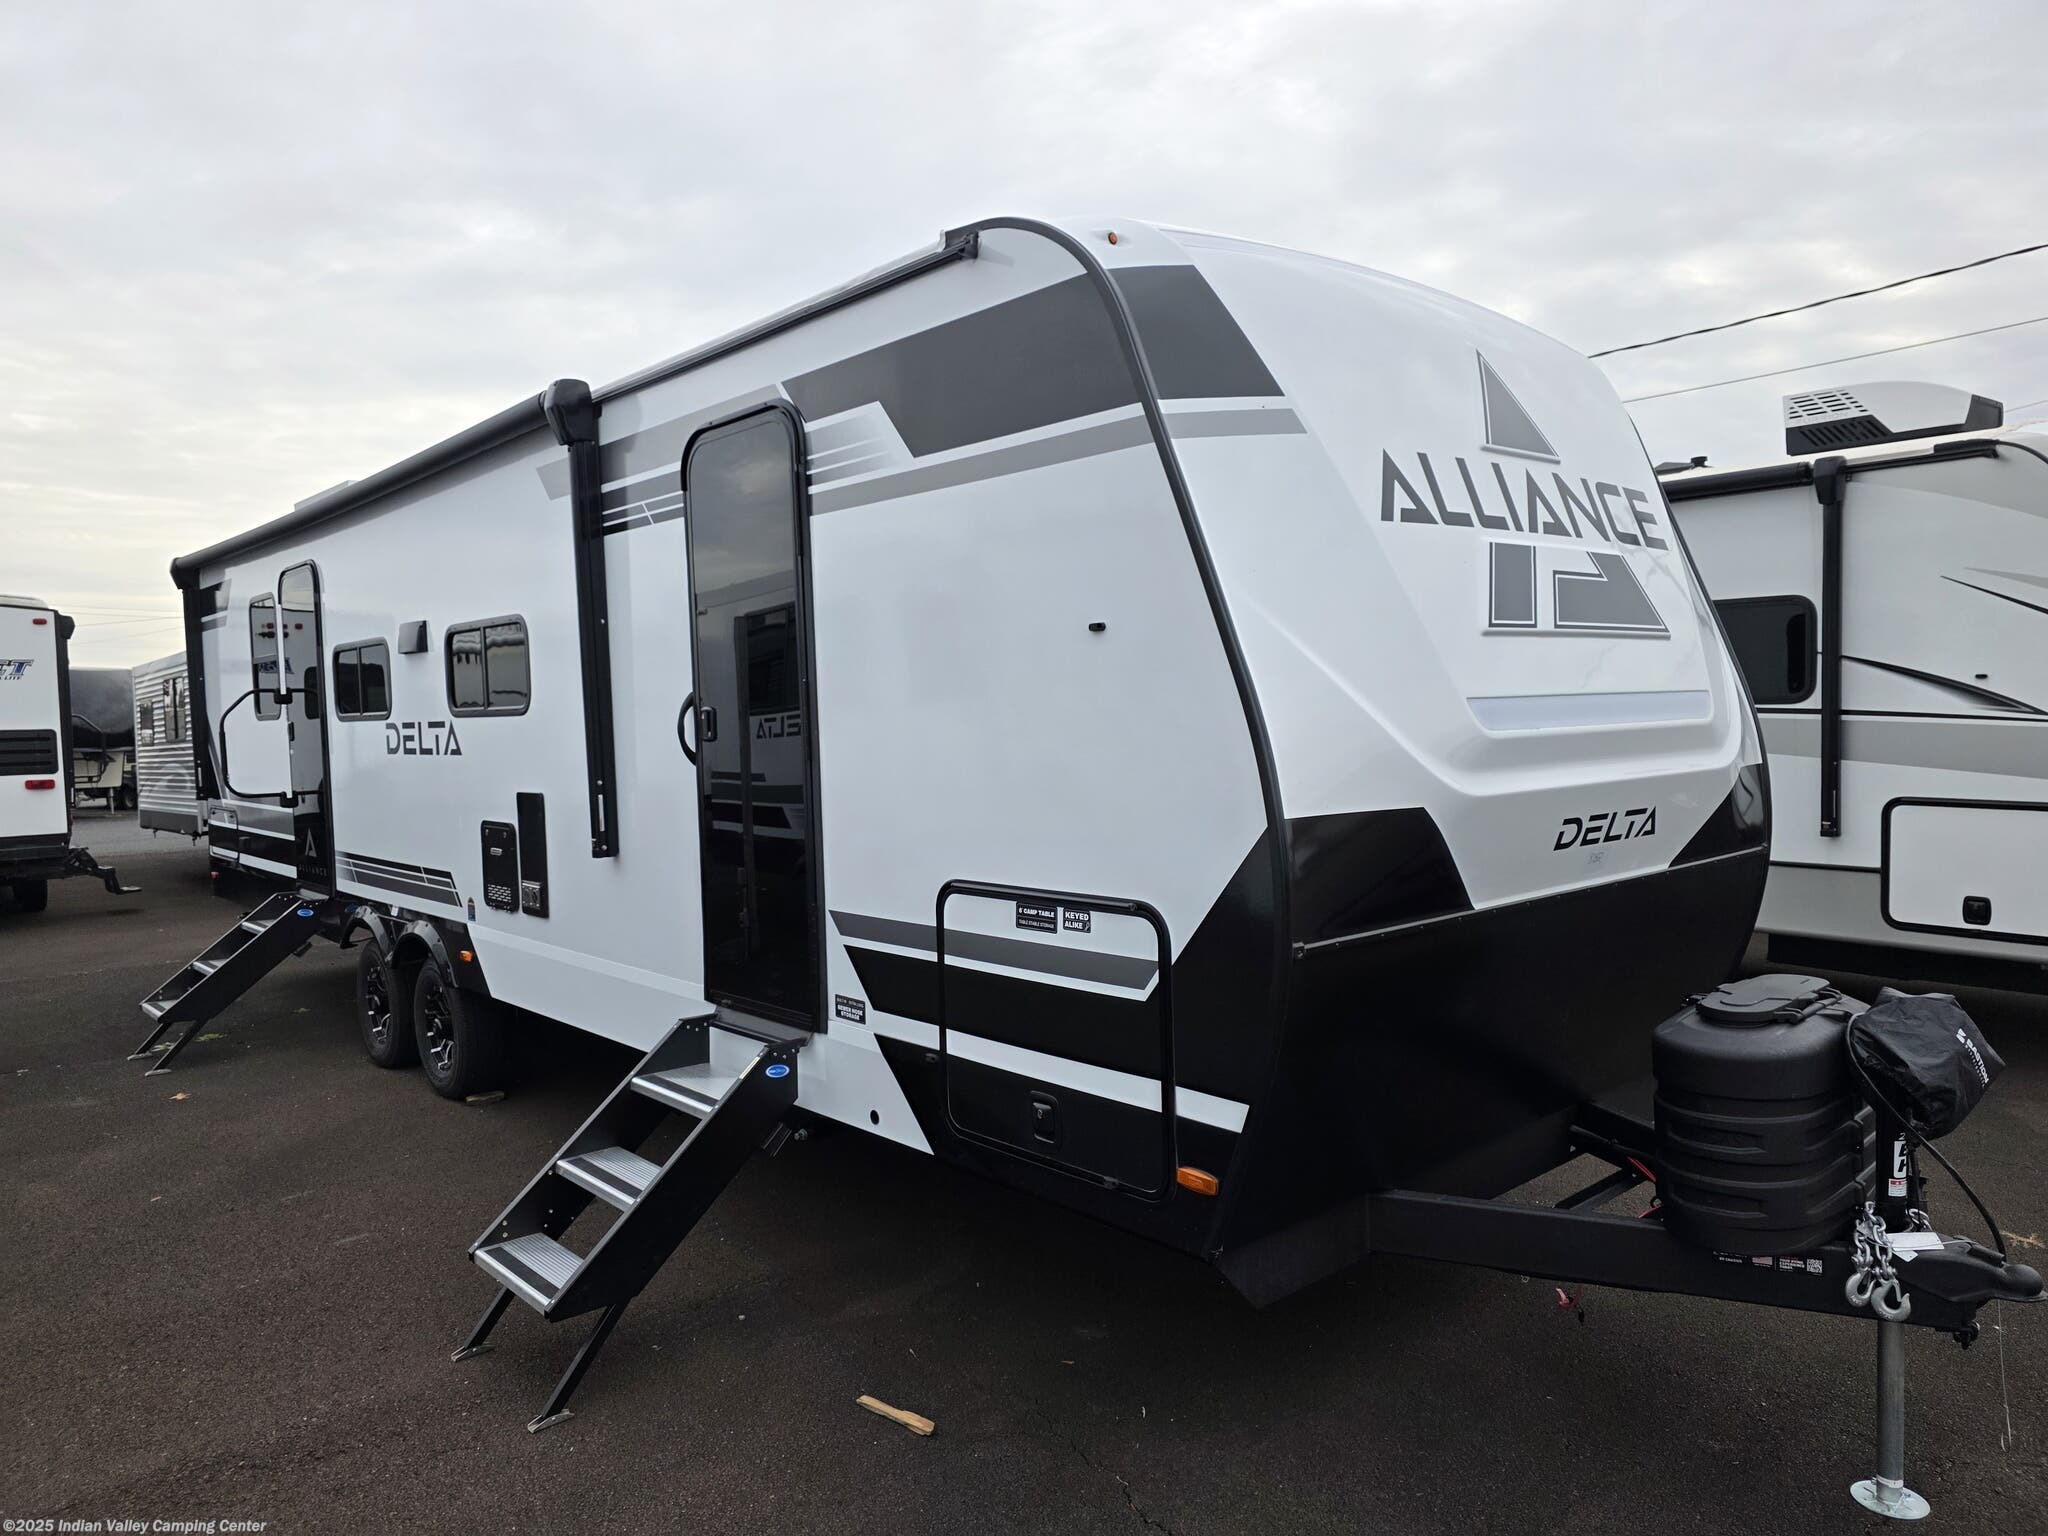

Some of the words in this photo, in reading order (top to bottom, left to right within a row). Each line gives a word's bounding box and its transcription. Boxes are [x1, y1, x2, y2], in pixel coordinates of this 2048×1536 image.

[1381, 448, 1669, 551] ALLIANCE
[385, 720, 463, 756] DELTA
[1553, 806, 1657, 851] DELTA
[1038, 910, 1055, 918] TABLE
[1065, 911, 1089, 921] KEYED
[1065, 920, 1083, 929] ALIKE
[1966, 1038, 1990, 1084] BASTION
